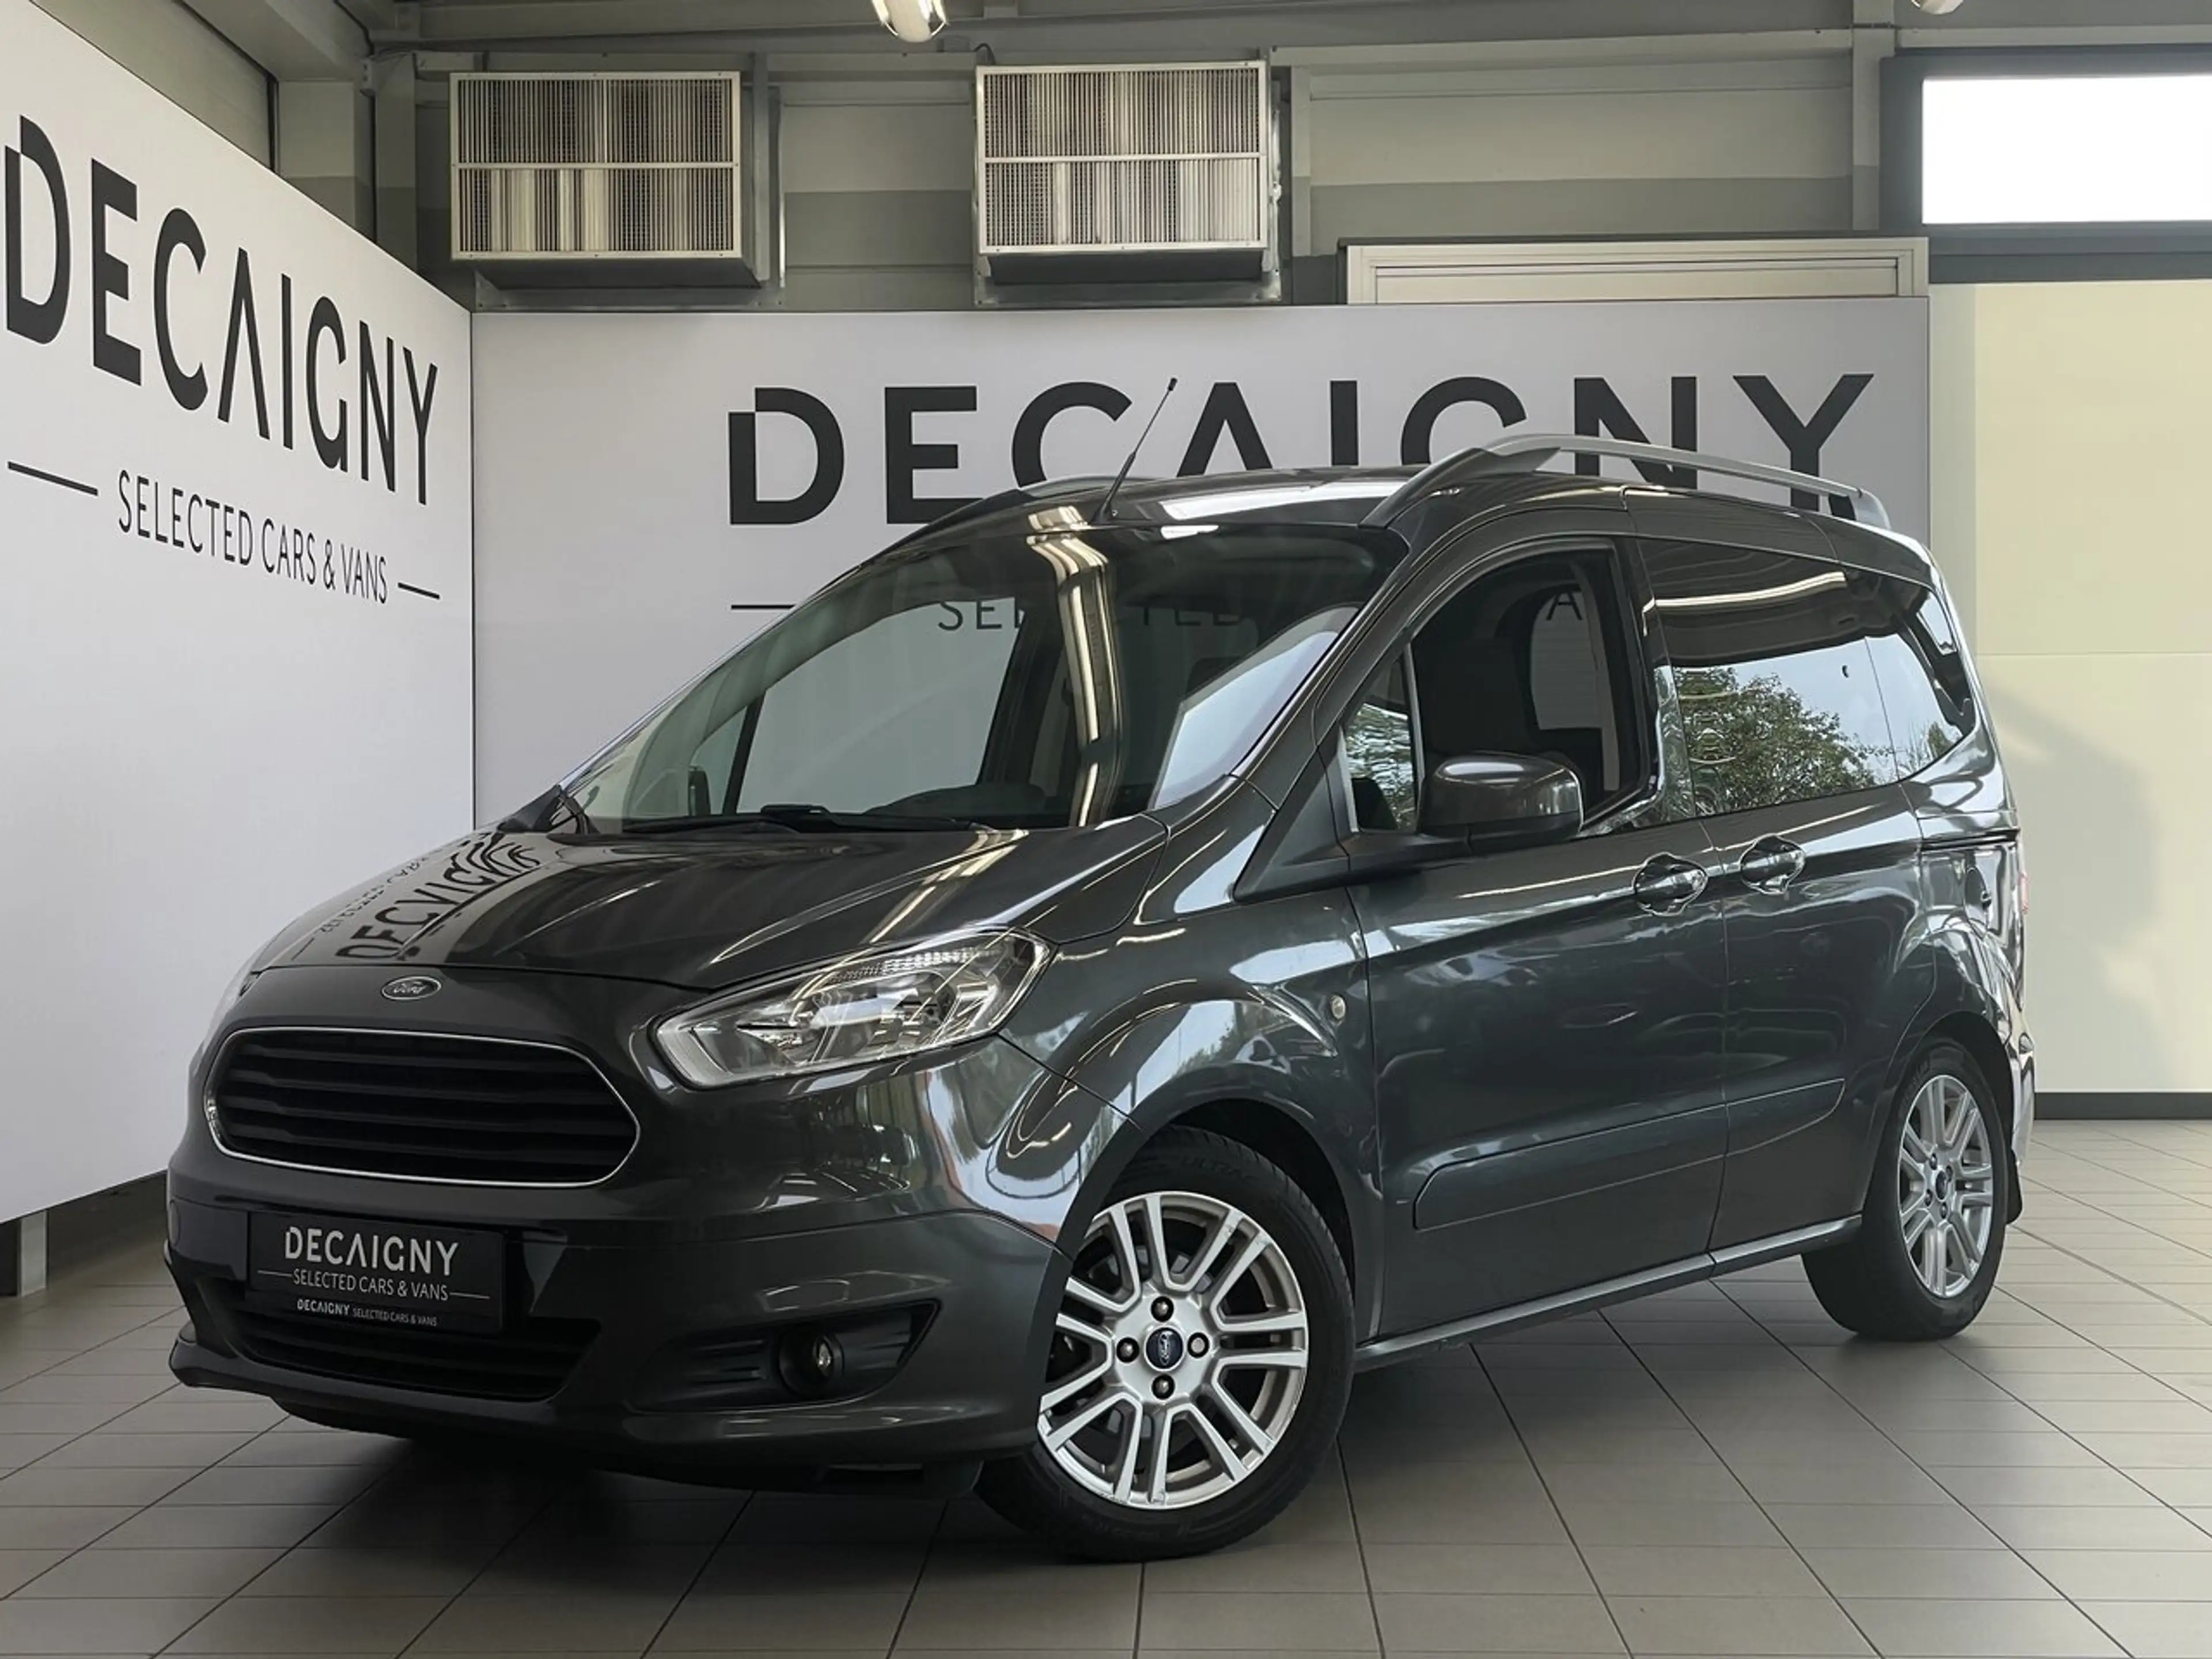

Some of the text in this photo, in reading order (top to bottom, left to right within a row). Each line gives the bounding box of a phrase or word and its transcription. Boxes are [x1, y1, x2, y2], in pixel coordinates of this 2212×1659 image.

[5, 115, 438, 505] DECAIGNY
[118, 469, 388, 604] SELECTED CARS & VANS
[285, 1226, 459, 1276] DECAIGNY
[293, 1268, 449, 1301] SELECTED CARS & VANS
[297, 1299, 350, 1316] DECAIGNY
[353, 1308, 390, 1321] SELECTED
